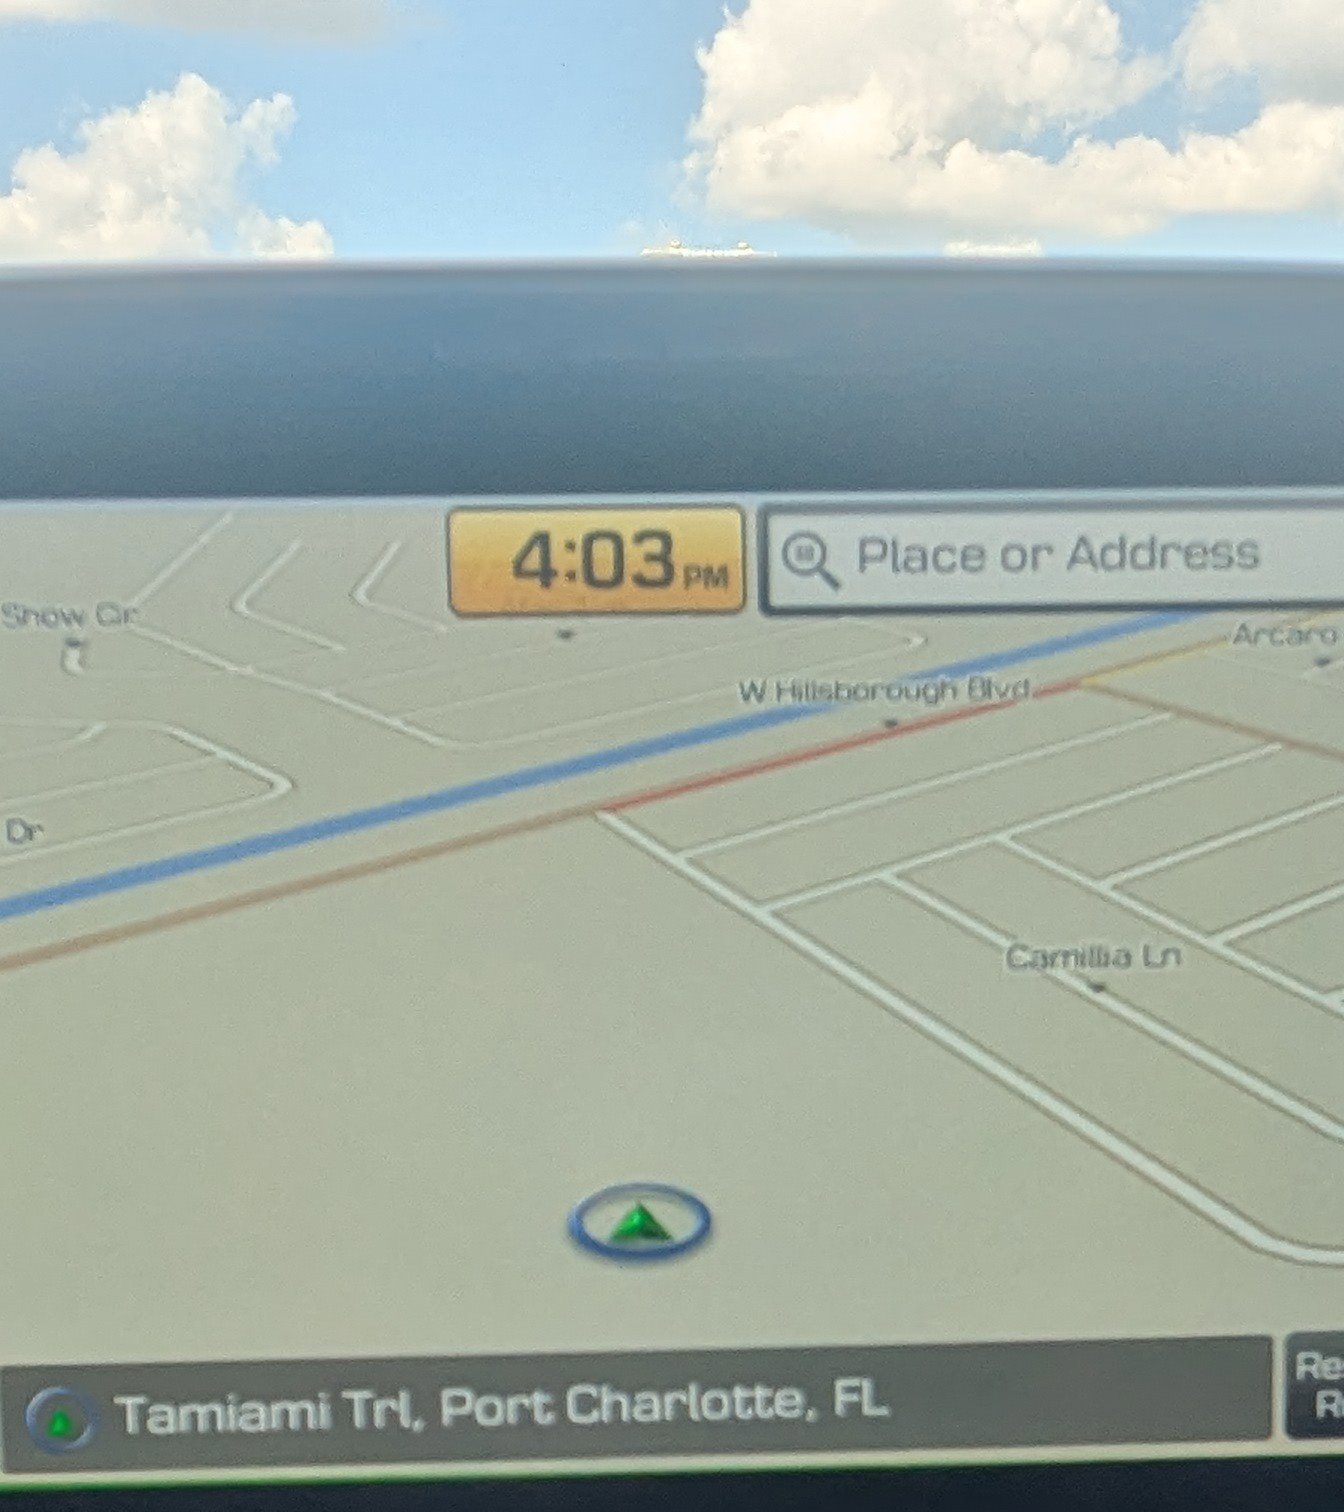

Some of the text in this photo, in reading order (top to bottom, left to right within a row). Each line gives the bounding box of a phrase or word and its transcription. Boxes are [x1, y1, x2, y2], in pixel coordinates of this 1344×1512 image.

[512, 528, 730, 591] 4:03 PM
[857, 533, 1261, 576] Place or Address
[739, 676, 1030, 706] W Hillsborough Blvd
[6, 817, 44, 845] Dr
[1143, 944, 1182, 970] Ln
[114, 1378, 891, 1437] Tamiami Trl, Port Charlotte, FL
